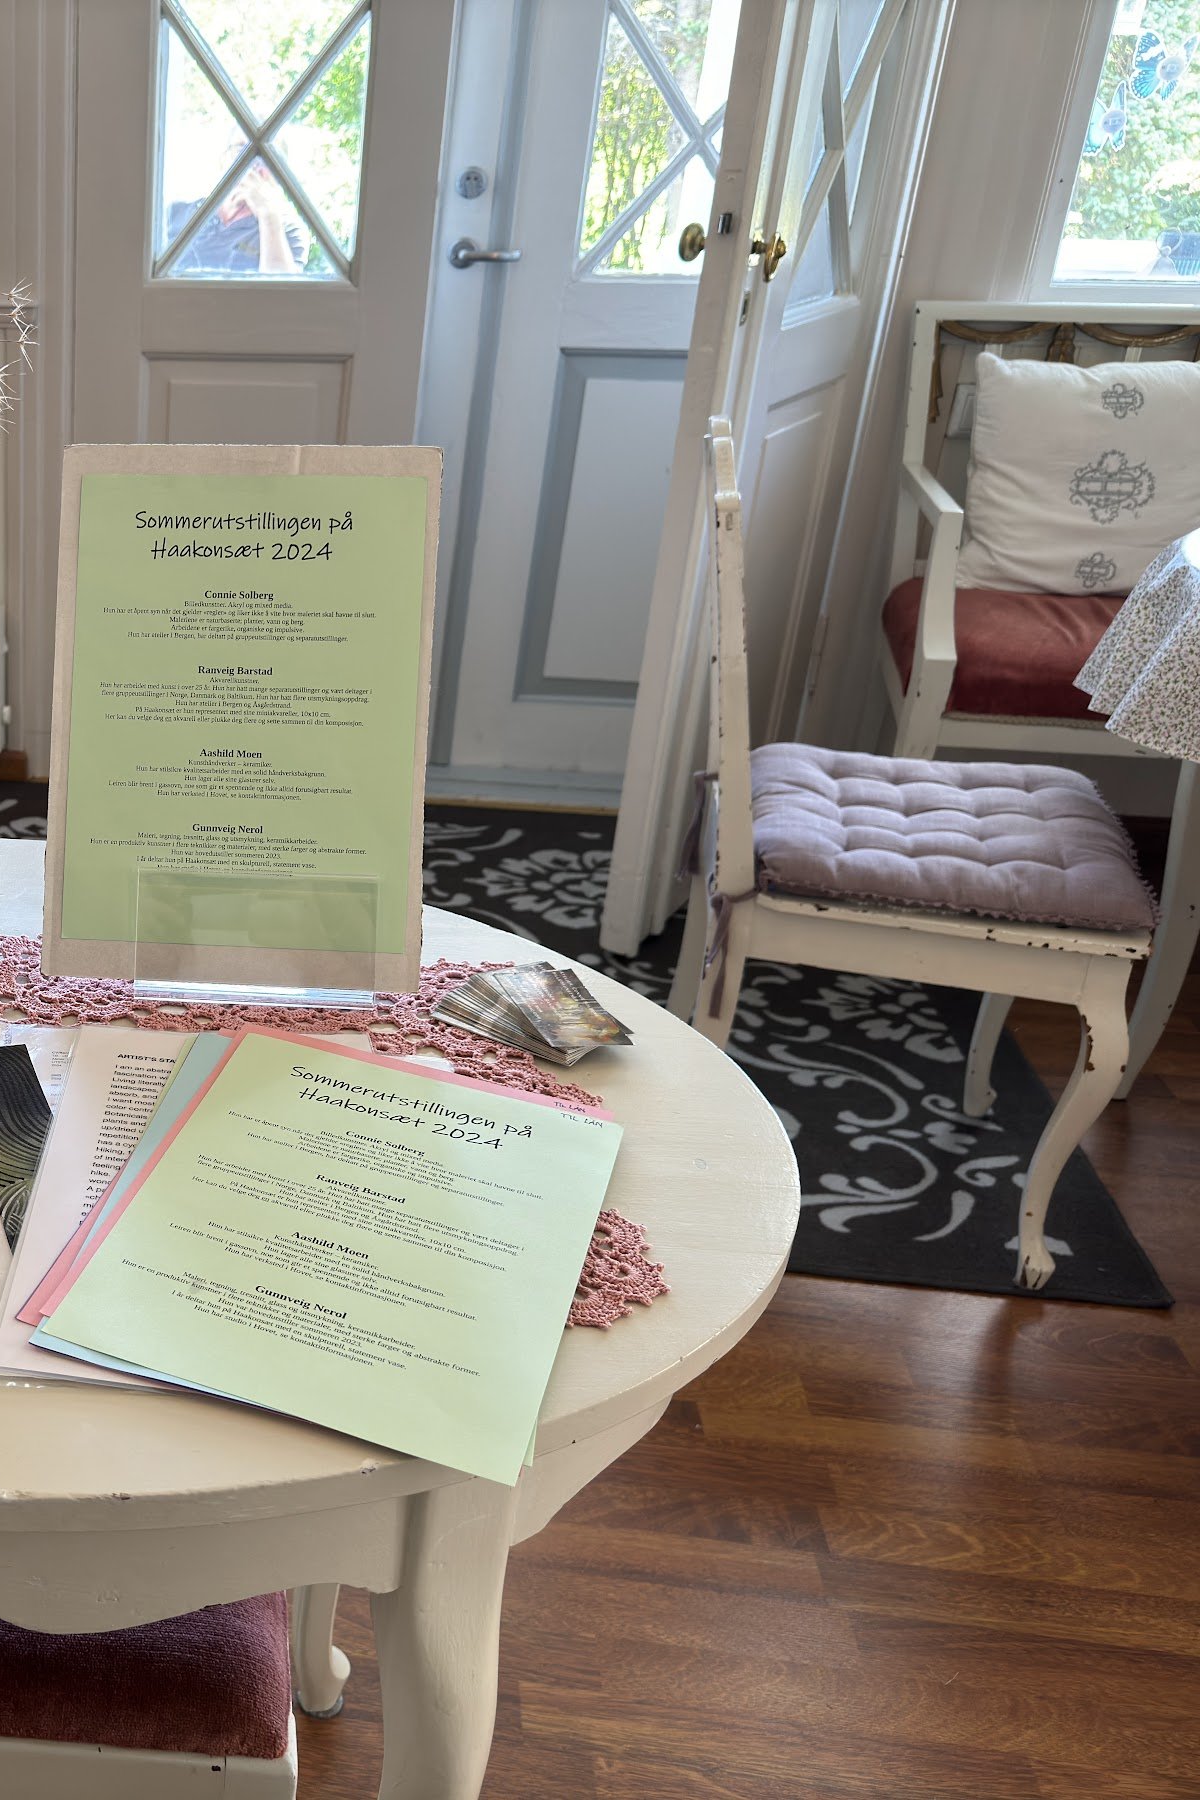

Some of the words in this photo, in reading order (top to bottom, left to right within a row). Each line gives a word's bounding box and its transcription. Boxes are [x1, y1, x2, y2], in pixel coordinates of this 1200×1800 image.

[135, 510, 321, 537] Sommerutstillingen
[329, 511, 353, 534] på
[151, 537, 264, 559] Haakonsæt
[271, 542, 333, 560] 2024
[204, 590, 236, 598] Connie
[238, 590, 274, 601] Solberg
[197, 666, 234, 676] Ranveig
[236, 666, 272, 675] Barstad
[198, 748, 234, 757] Aashild
[235, 750, 262, 758] Moen
[191, 823, 236, 834] Gunnveig
[237, 825, 263, 833] Nerol
[114, 1070, 157, 1079] fascination
[110, 1083, 159, 1093] landscapes,
[138, 1079, 166, 1087] literally
[109, 1090, 140, 1098] absorb,
[290, 1065, 495, 1130] Sommerutstillingen
[503, 1125, 532, 1139] på
[104, 1110, 148, 1120] Botanicals
[299, 1087, 425, 1128] Haakonsæt
[433, 1123, 503, 1150] 2024
[560, 1112, 579, 1121] TIL
[102, 1117, 128, 1125] plants
[100, 1125, 137, 1133] up/dried
[99, 1132, 139, 1141] repetition
[345, 1130, 382, 1144] Connie
[384, 1141, 425, 1156] Solberg
[95, 1147, 125, 1155] Hiking,
[92, 1162, 121, 1171] feeling
[90, 1169, 111, 1177] hike.
[314, 1174, 360, 1192] Ranveig
[360, 1187, 405, 1204] Barstad
[290, 1231, 334, 1249] Aashild
[335, 1244, 368, 1259] Moen
[254, 1285, 311, 1309] Gunnveig
[312, 1303, 347, 1319] Nerol
[182, 1271, 207, 1284] Maleri,
[209, 1280, 237, 1293] tegning,
[239, 1290, 266, 1302] tresnitt,
[267, 1300, 287, 1308] glass
[299, 1309, 345, 1328] utsmykning,
[346, 1323, 416, 1349] keramikkarbeider.
[121, 1258, 136, 1267] Hun
[154, 1270, 190, 1284] produktiv
[190, 1281, 222, 1295] kunstner
[226, 1293, 244, 1302] flere
[245, 1299, 280, 1313] teknikker
[291, 1314, 331, 1331] materialer,
[333, 1327, 351, 1336] med
[351, 1333, 375, 1344] sterke
[376, 1340, 400, 1351] farger
[413, 1353, 450, 1367] abstrakte
[451, 1363, 480, 1377] former.
[217, 1297, 233, 1306] Hun
[247, 1306, 299, 1327] hovedutstiller
[299, 1324, 339, 1340] sommeren
[184, 1294, 206, 1304] deltar
[206, 1300, 221, 1309] hun
[232, 1309, 274, 1326] Haakonsæt
[274, 1323, 292, 1332] med
[347, 1347, 385, 1362] statement
[387, 1359, 406, 1369] vase.
[193, 1304, 209, 1313] Hun
[210, 1309, 224, 1317] har
[223, 1315, 247, 1325] studio
[252, 1323, 277, 1336] Hovet,
[289, 1334, 374, 1366] kontaktinformasjonen.
